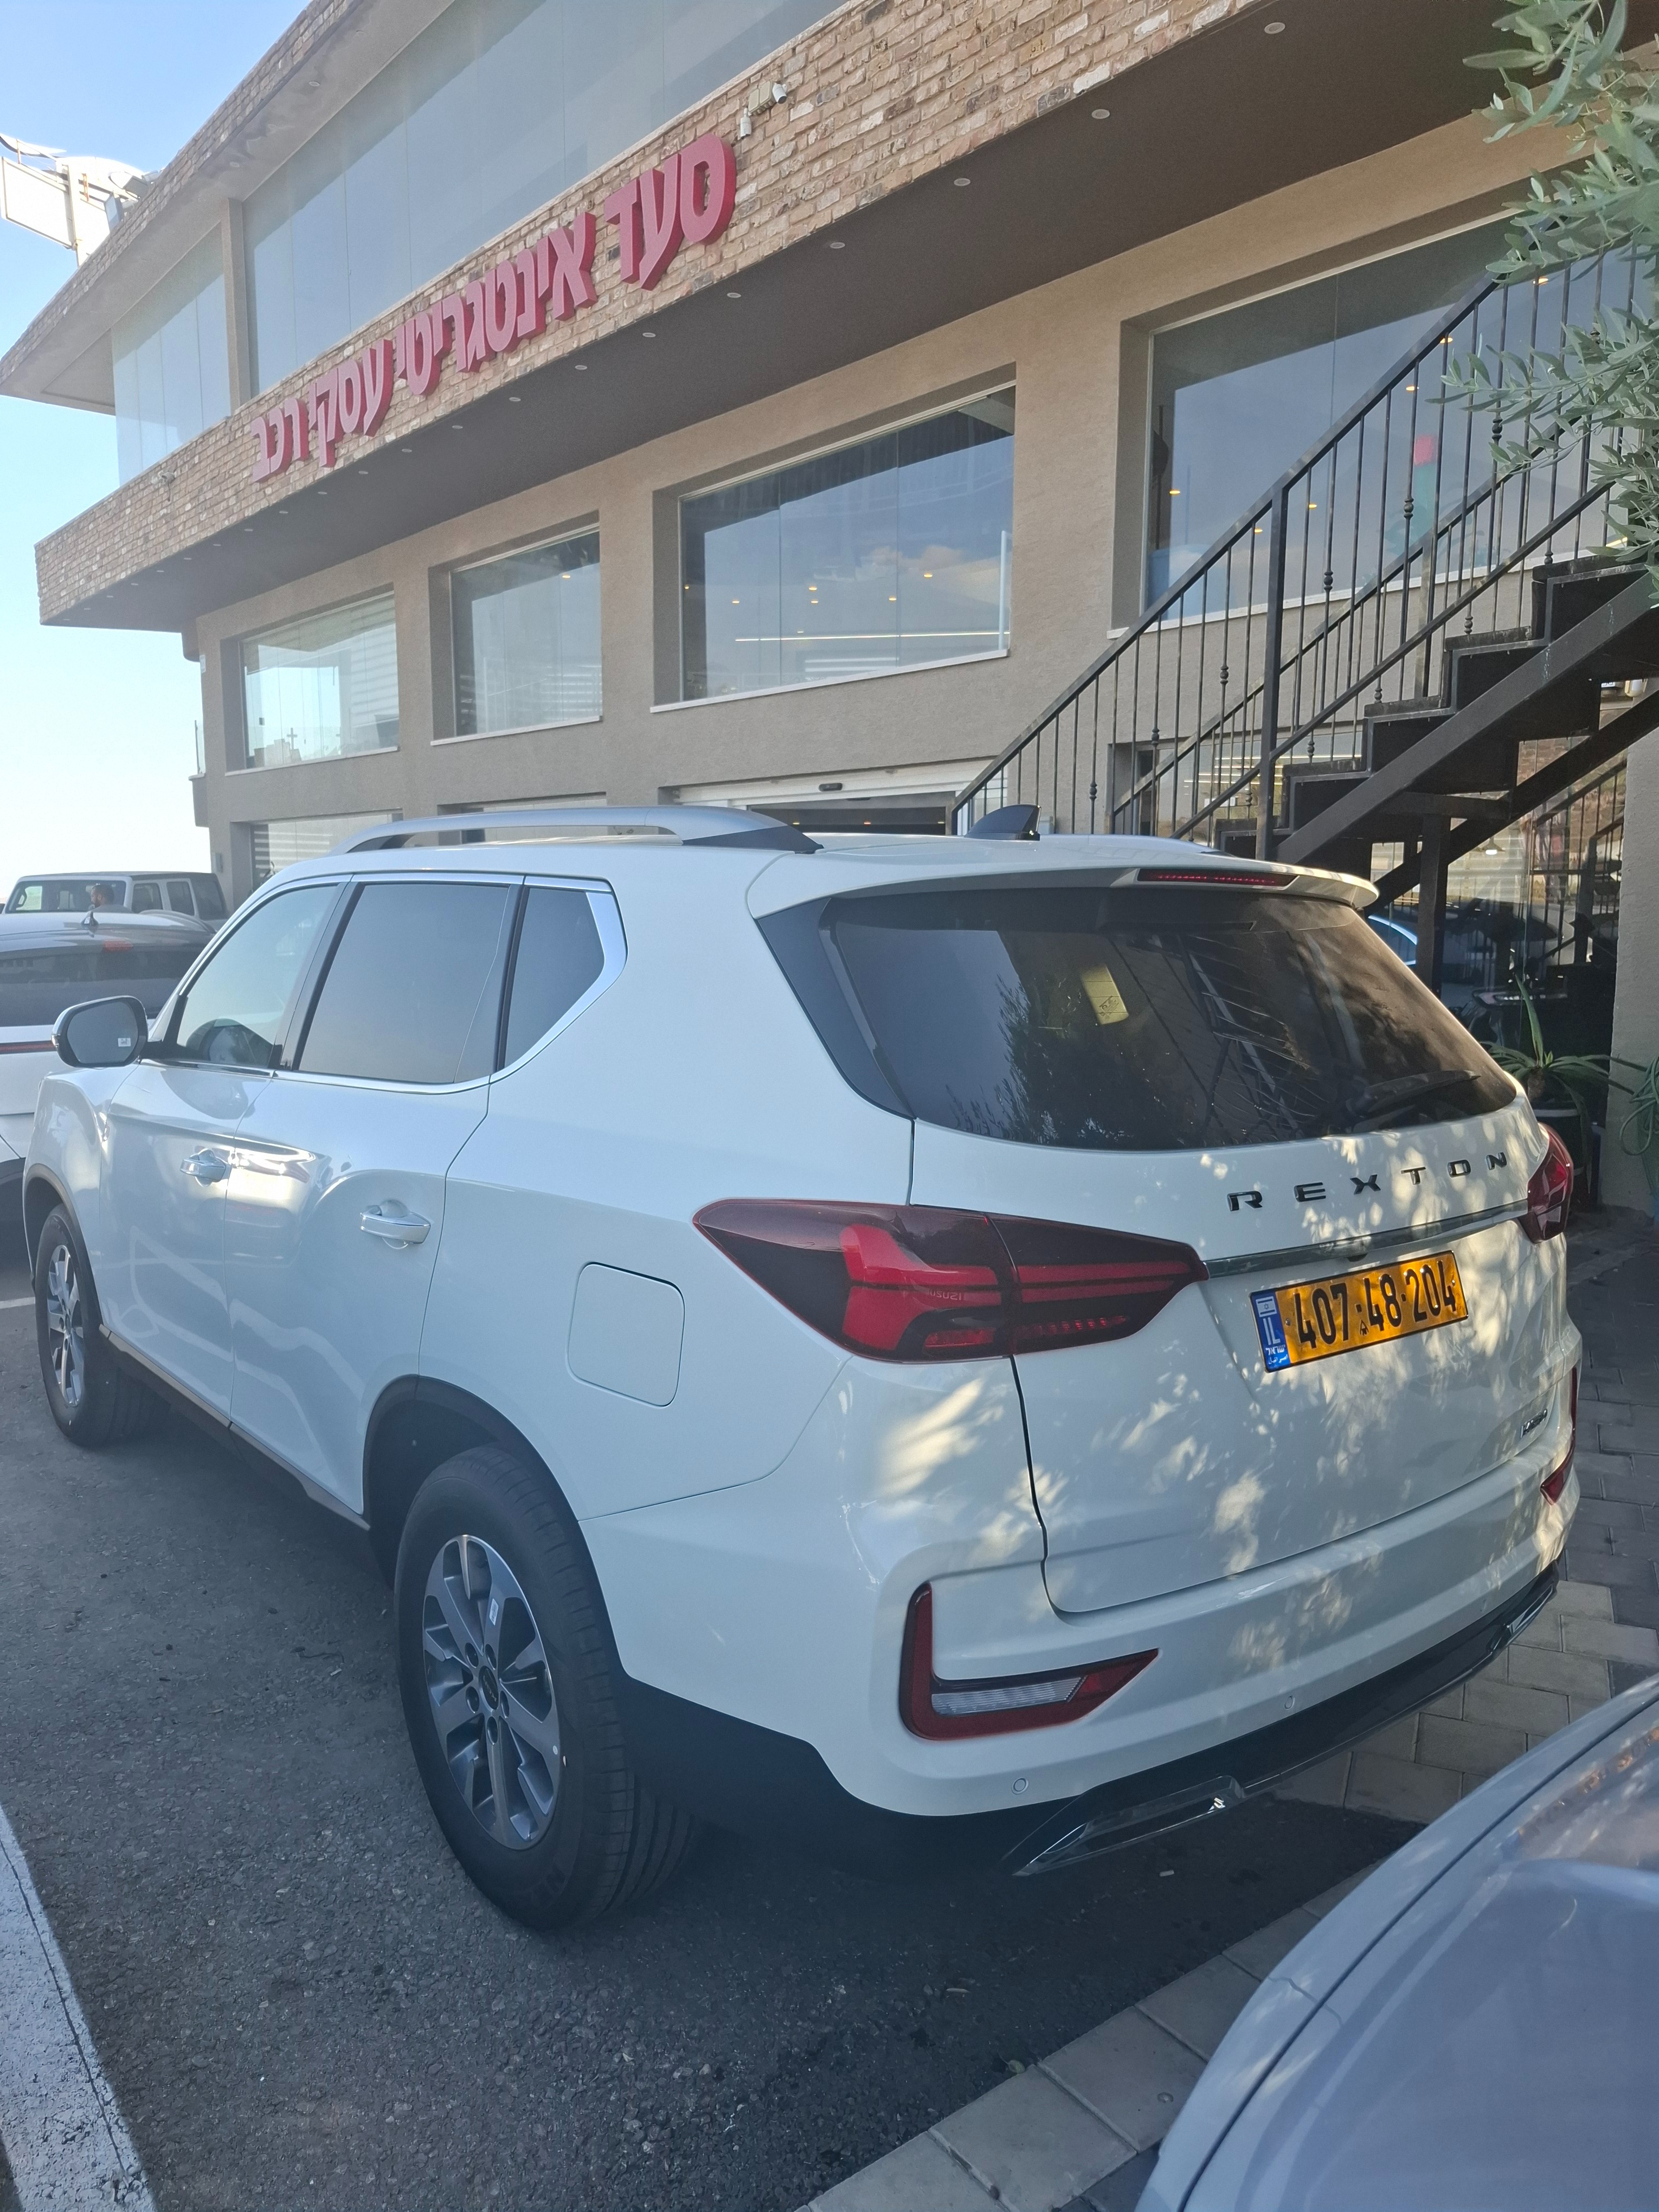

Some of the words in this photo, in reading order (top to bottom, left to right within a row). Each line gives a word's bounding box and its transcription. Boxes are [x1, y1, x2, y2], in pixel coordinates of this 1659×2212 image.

[603, 133, 737, 291] סעד
[395, 211, 597, 396] אינטגריטי
[251, 397, 310, 483] רכב
[307, 338, 394, 468] עסקי
[1226, 1151, 1508, 1212] REXTON
[1263, 1317, 1281, 1345] IL
[1265, 1344, 1286, 1355] ישראל
